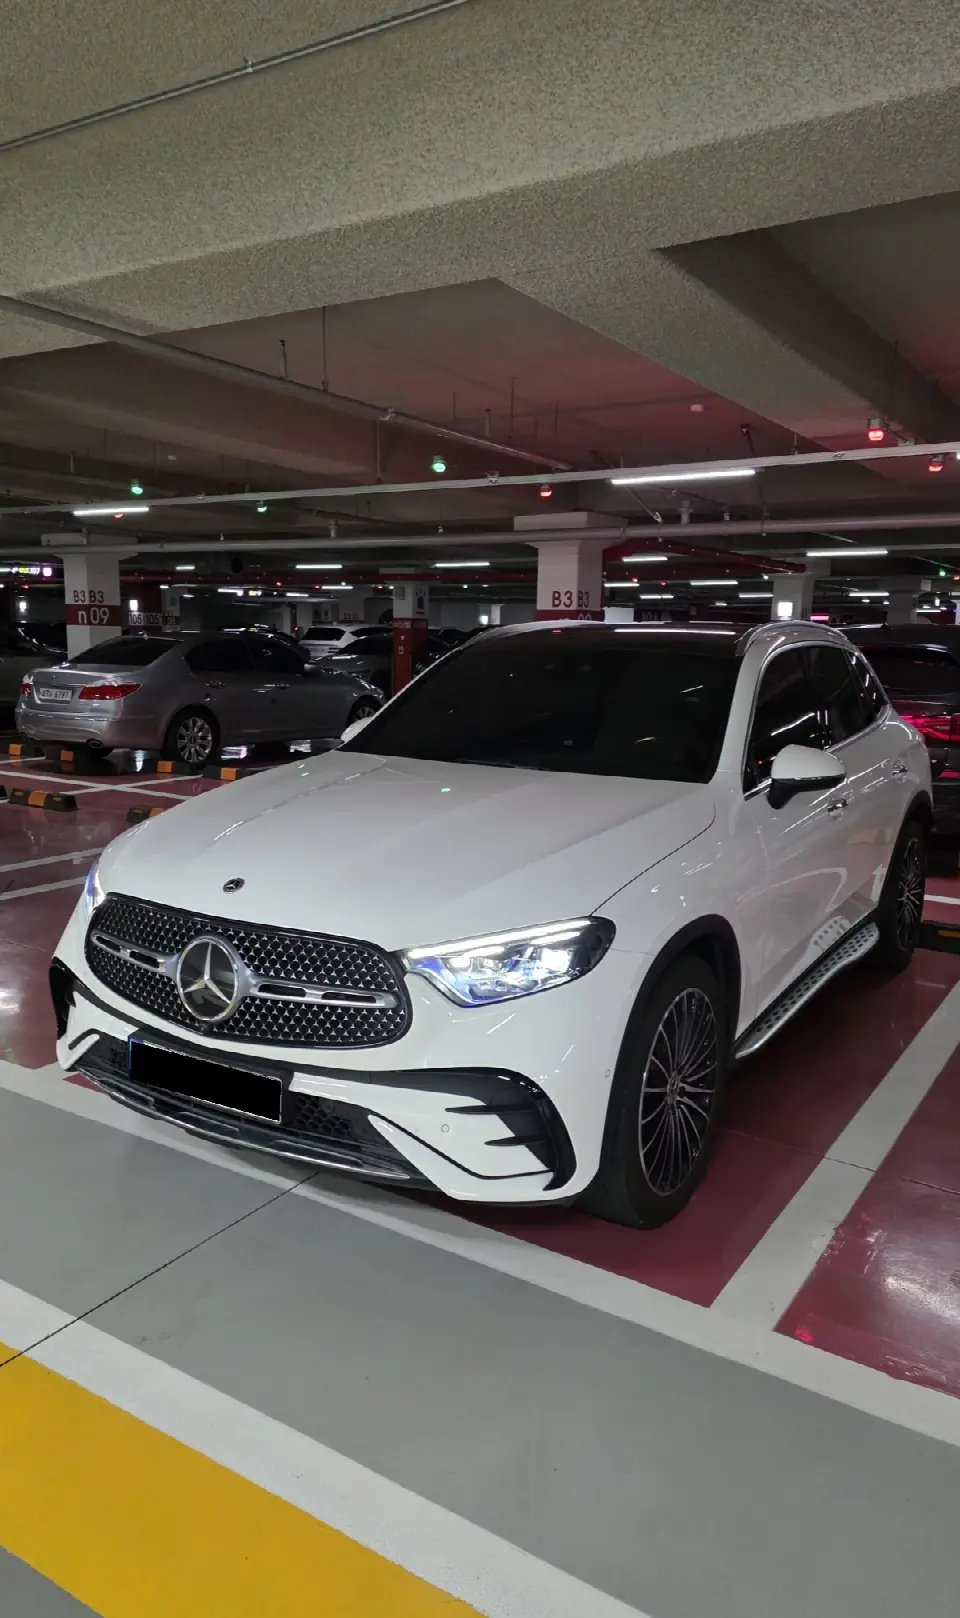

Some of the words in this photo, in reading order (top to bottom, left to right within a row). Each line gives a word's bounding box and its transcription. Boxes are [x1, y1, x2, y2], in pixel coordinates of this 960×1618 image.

[73, 590, 86, 603] B3
[88, 590, 104, 604] B3
[552, 590, 573, 608] B3
[577, 590, 590, 608] B3
[90, 607, 109, 624] 09
